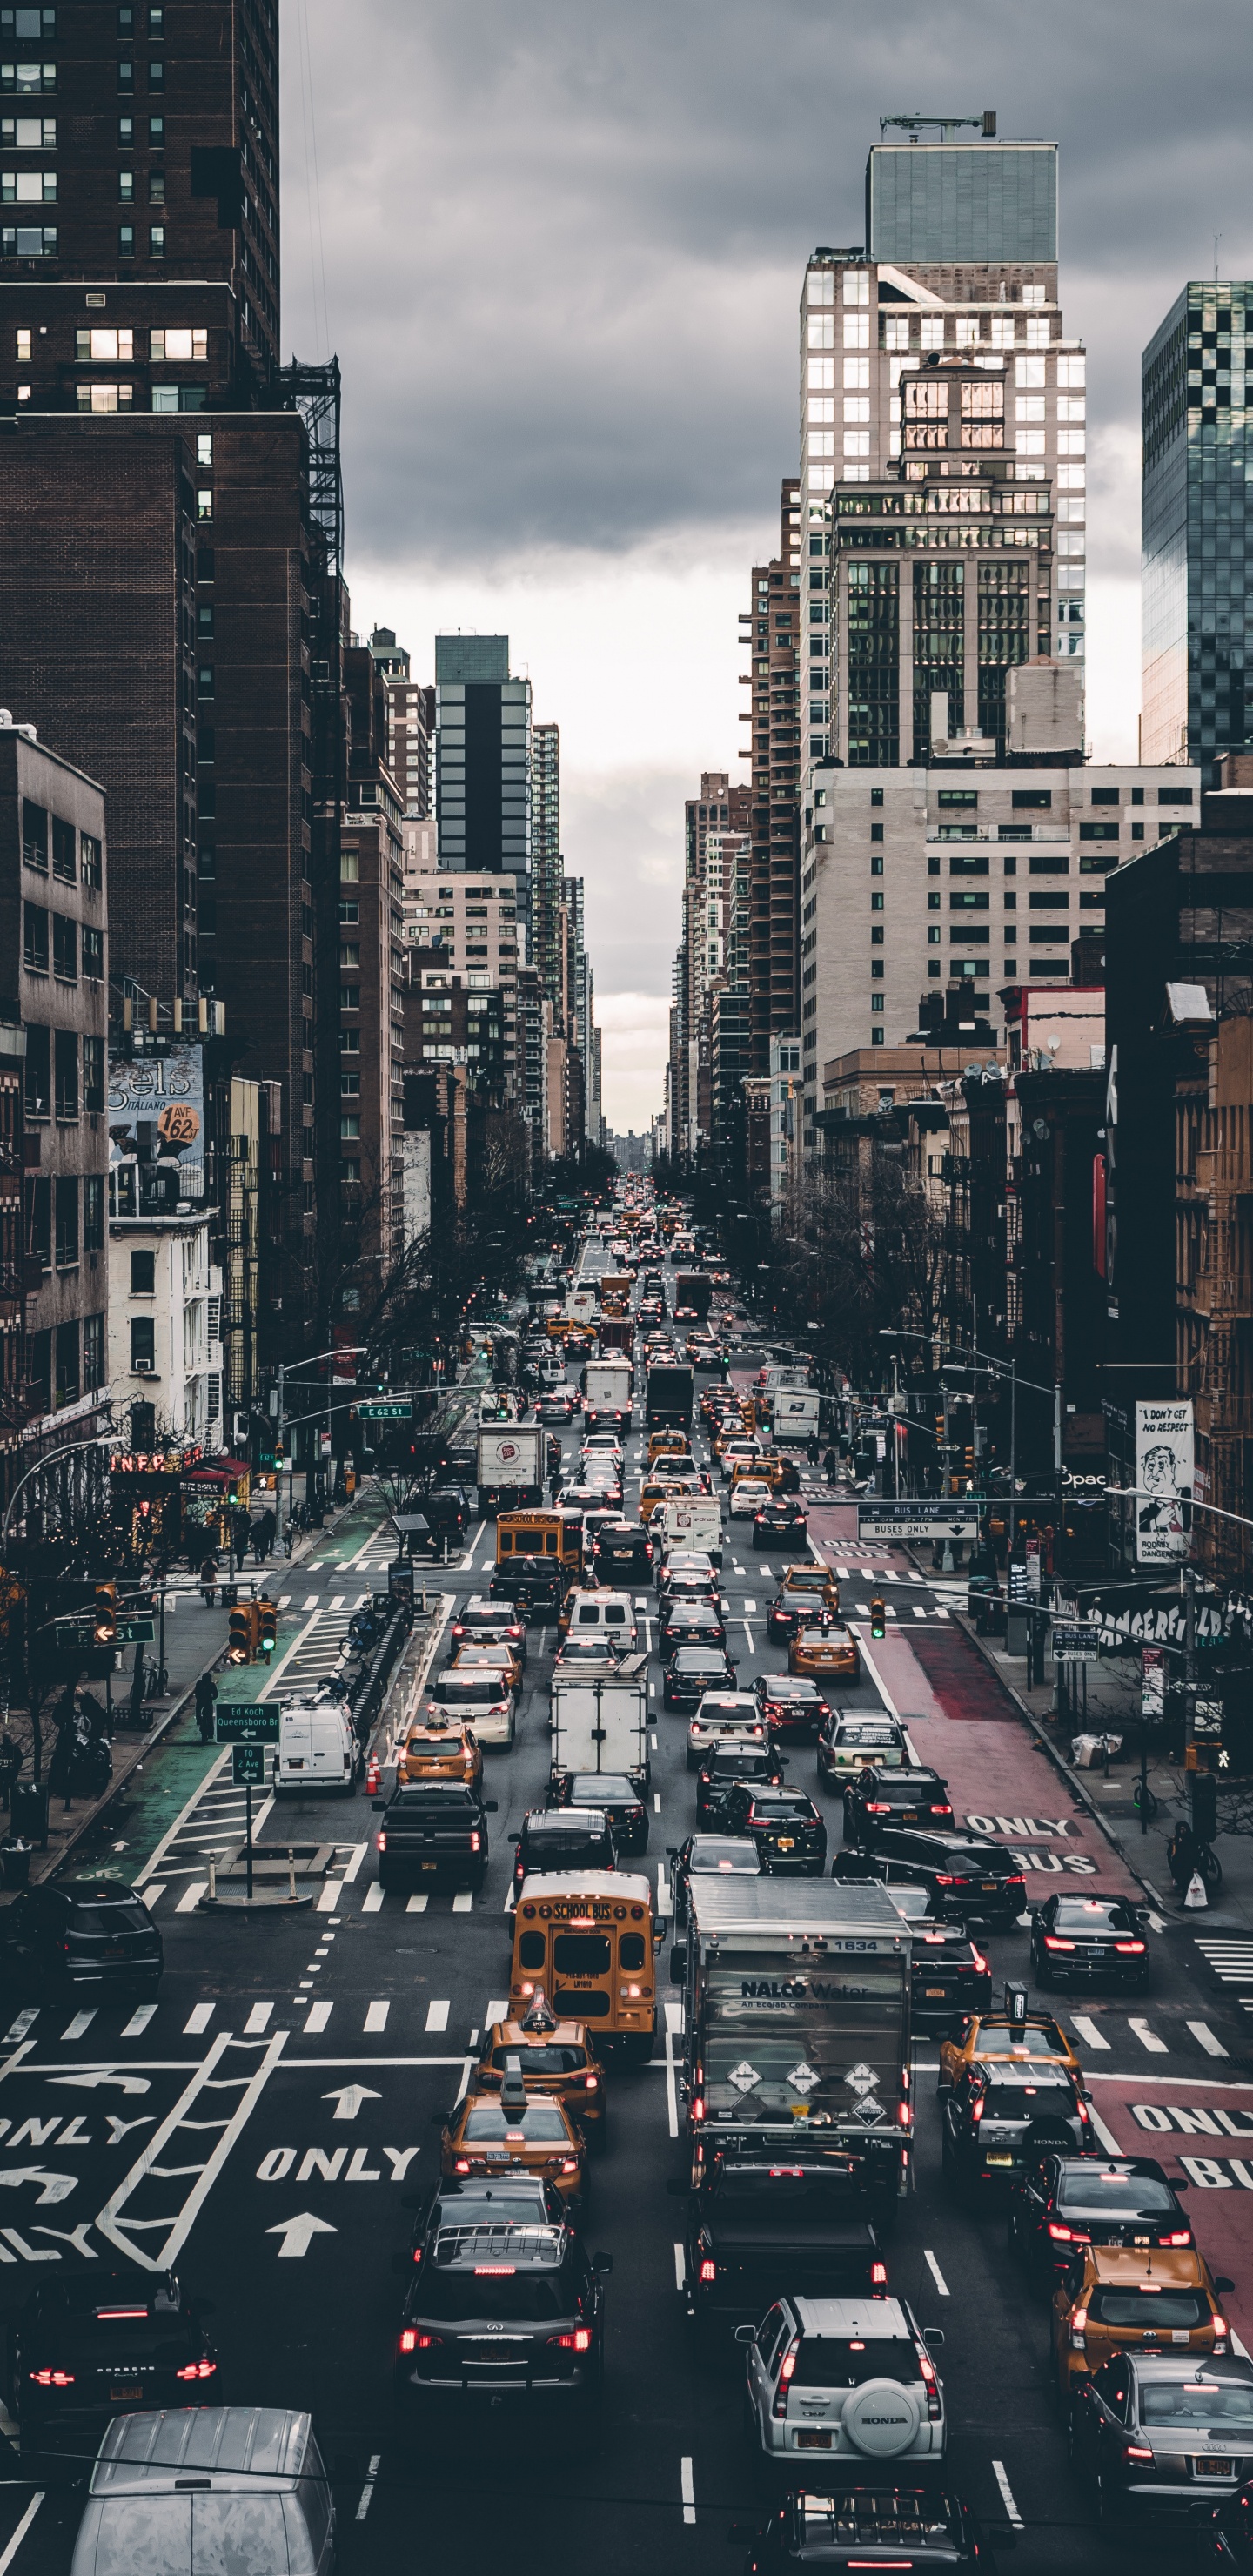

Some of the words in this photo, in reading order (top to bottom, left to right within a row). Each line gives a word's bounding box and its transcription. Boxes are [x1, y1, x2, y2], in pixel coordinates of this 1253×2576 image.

[127, 1101, 166, 1110] ITALIANO
[164, 1107, 173, 1131] 1
[174, 1107, 191, 1118] AVE
[171, 1119, 192, 1139] 62
[188, 1129, 199, 1139] ST
[1150, 1408, 1172, 1419] DON'T
[1174, 1410, 1187, 1419] GET
[1142, 1424, 1155, 1432] NO
[824, 1540, 888, 1549] ONLY
[835, 1550, 891, 1559] BUS
[116, 1627, 133, 1640] St
[218, 1718, 266, 1727] Queensboro
[967, 1815, 1071, 1837] ONLY
[1009, 1852, 1096, 1874] BUS
[555, 1903, 590, 1919] SCHOOL
[593, 1903, 611, 1919] BUS
[834, 1942, 877, 1951] 1634
[741, 1982, 806, 1998] NALCO
[810, 1982, 869, 1999] Water
[256, 2148, 420, 2181] ONLY
